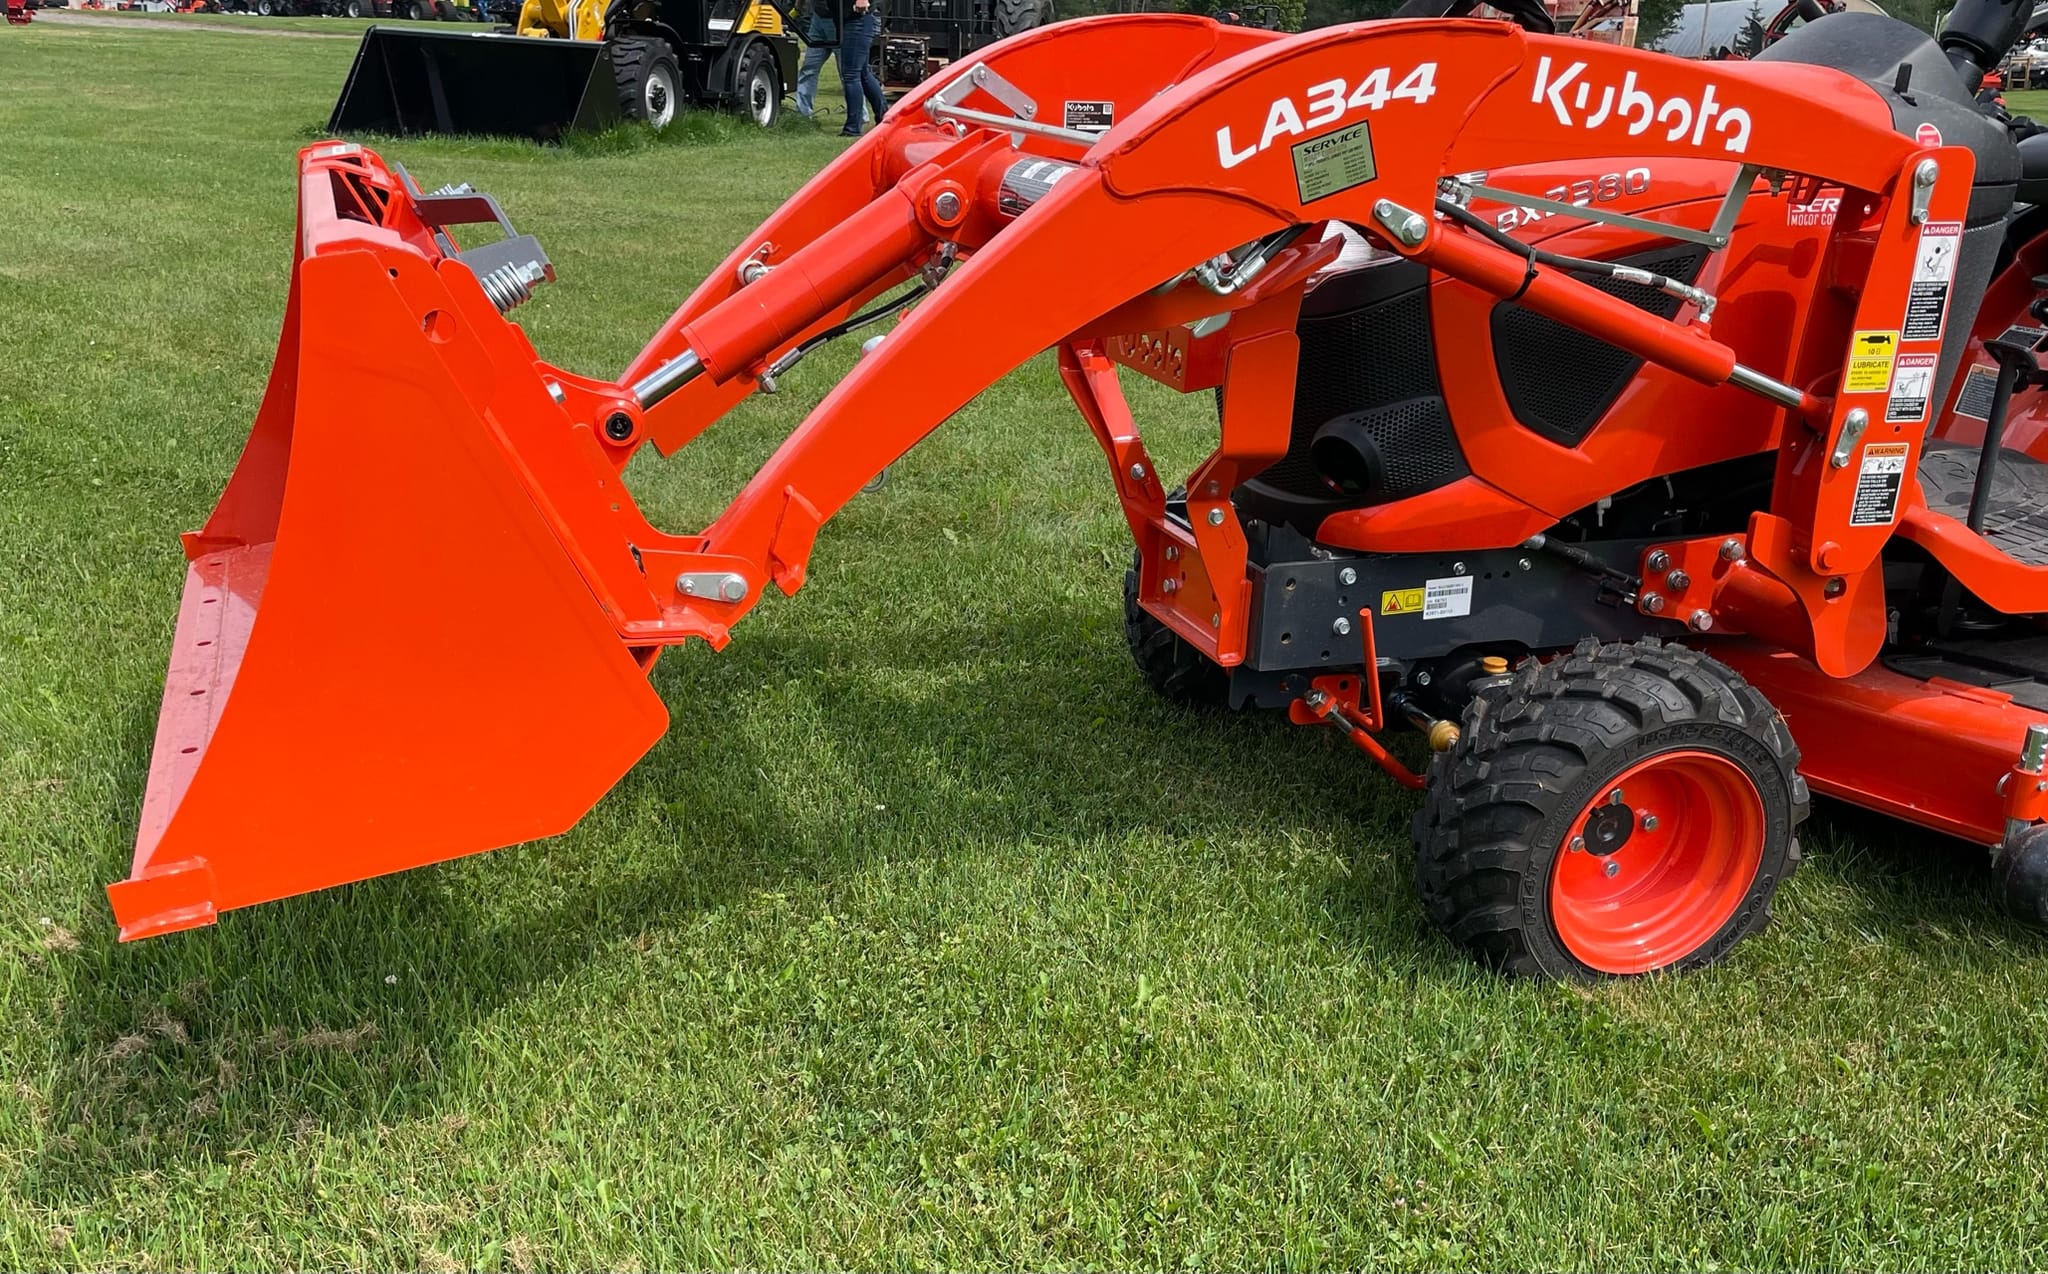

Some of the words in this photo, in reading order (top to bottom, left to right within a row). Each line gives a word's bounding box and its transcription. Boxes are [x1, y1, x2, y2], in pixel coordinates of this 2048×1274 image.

[1067, 103, 1095, 112] Kubota
[1531, 55, 1752, 154] Kubota
[1216, 62, 1438, 169] LA344
[1303, 128, 1363, 155] SERVICE
[1792, 197, 1841, 213] SER
[1930, 225, 1959, 234] DANGER
[1852, 360, 1890, 369] LUBRICATE
[1905, 357, 1934, 366] DANGER
[1874, 447, 1905, 455] WARNING
